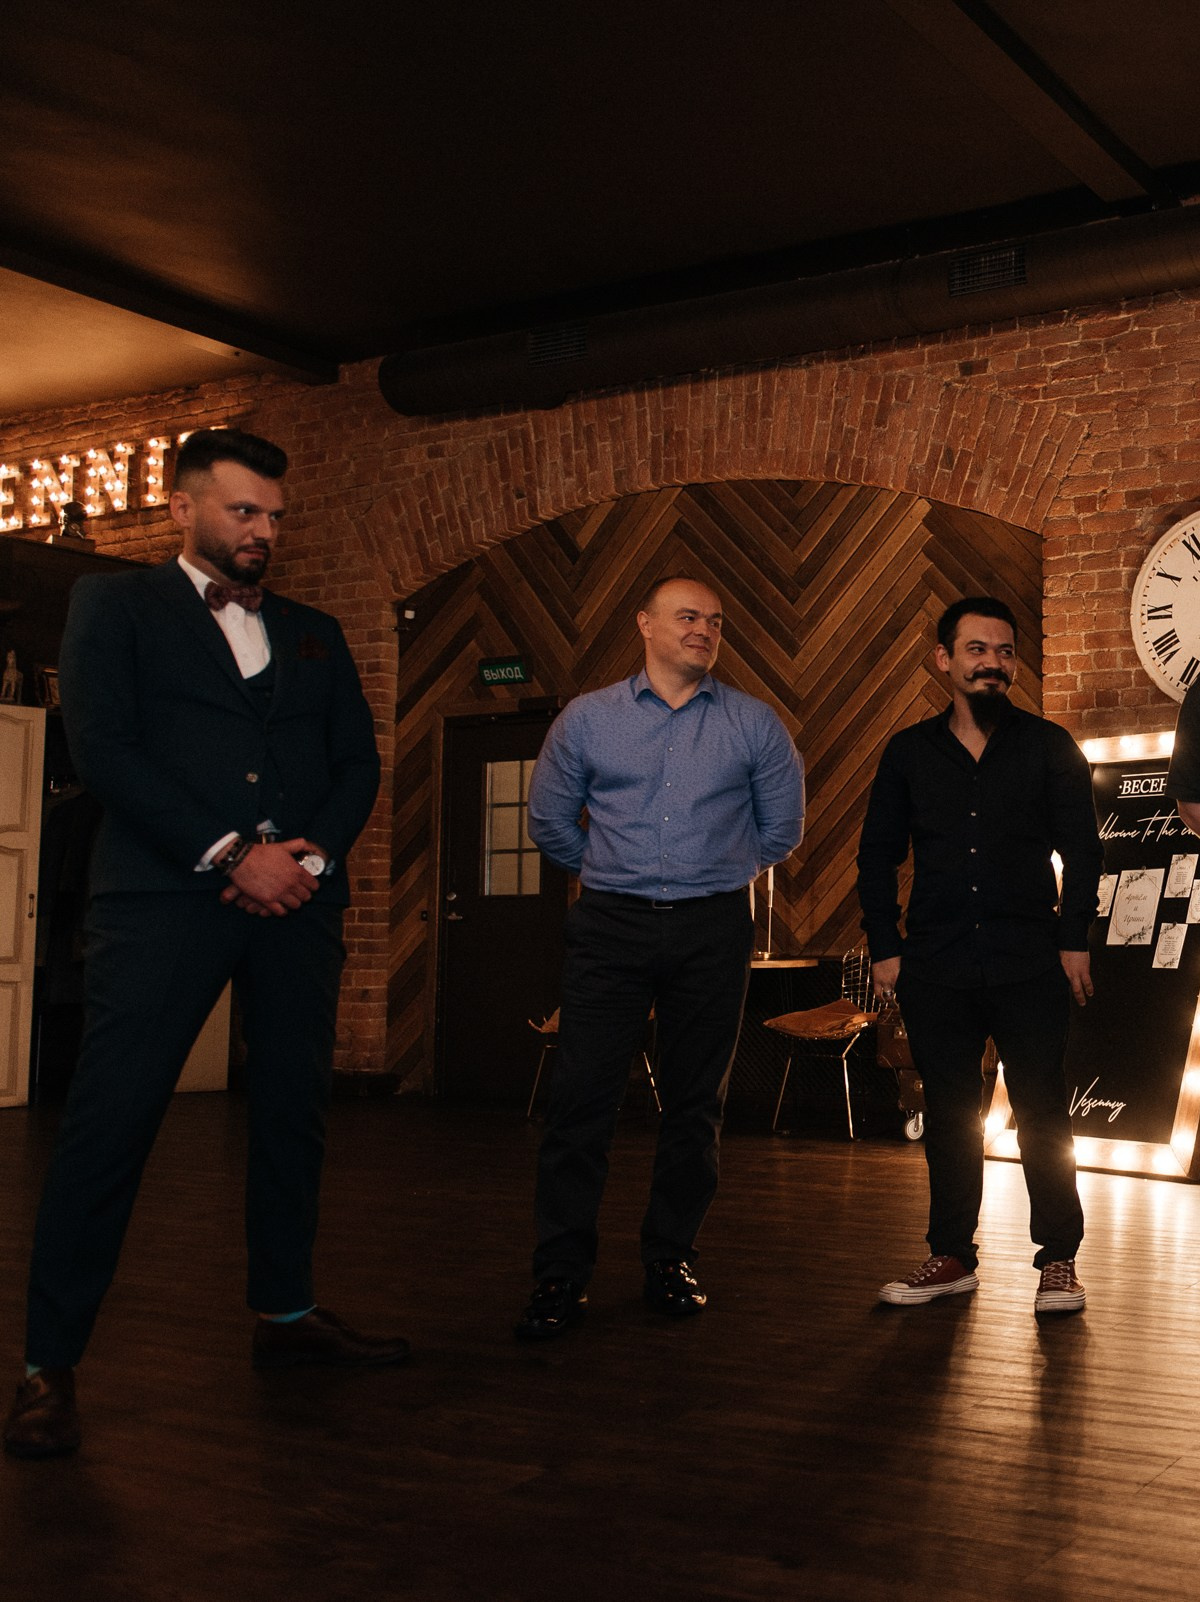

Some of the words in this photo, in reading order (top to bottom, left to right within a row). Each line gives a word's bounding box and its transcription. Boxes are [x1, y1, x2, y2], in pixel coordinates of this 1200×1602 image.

[0, 426, 228, 532] ENNI
[483, 666, 525, 681] ВЫХОД
[1120, 778, 1168, 795] ВЕСЕН
[1098, 812, 1141, 840] elcome
